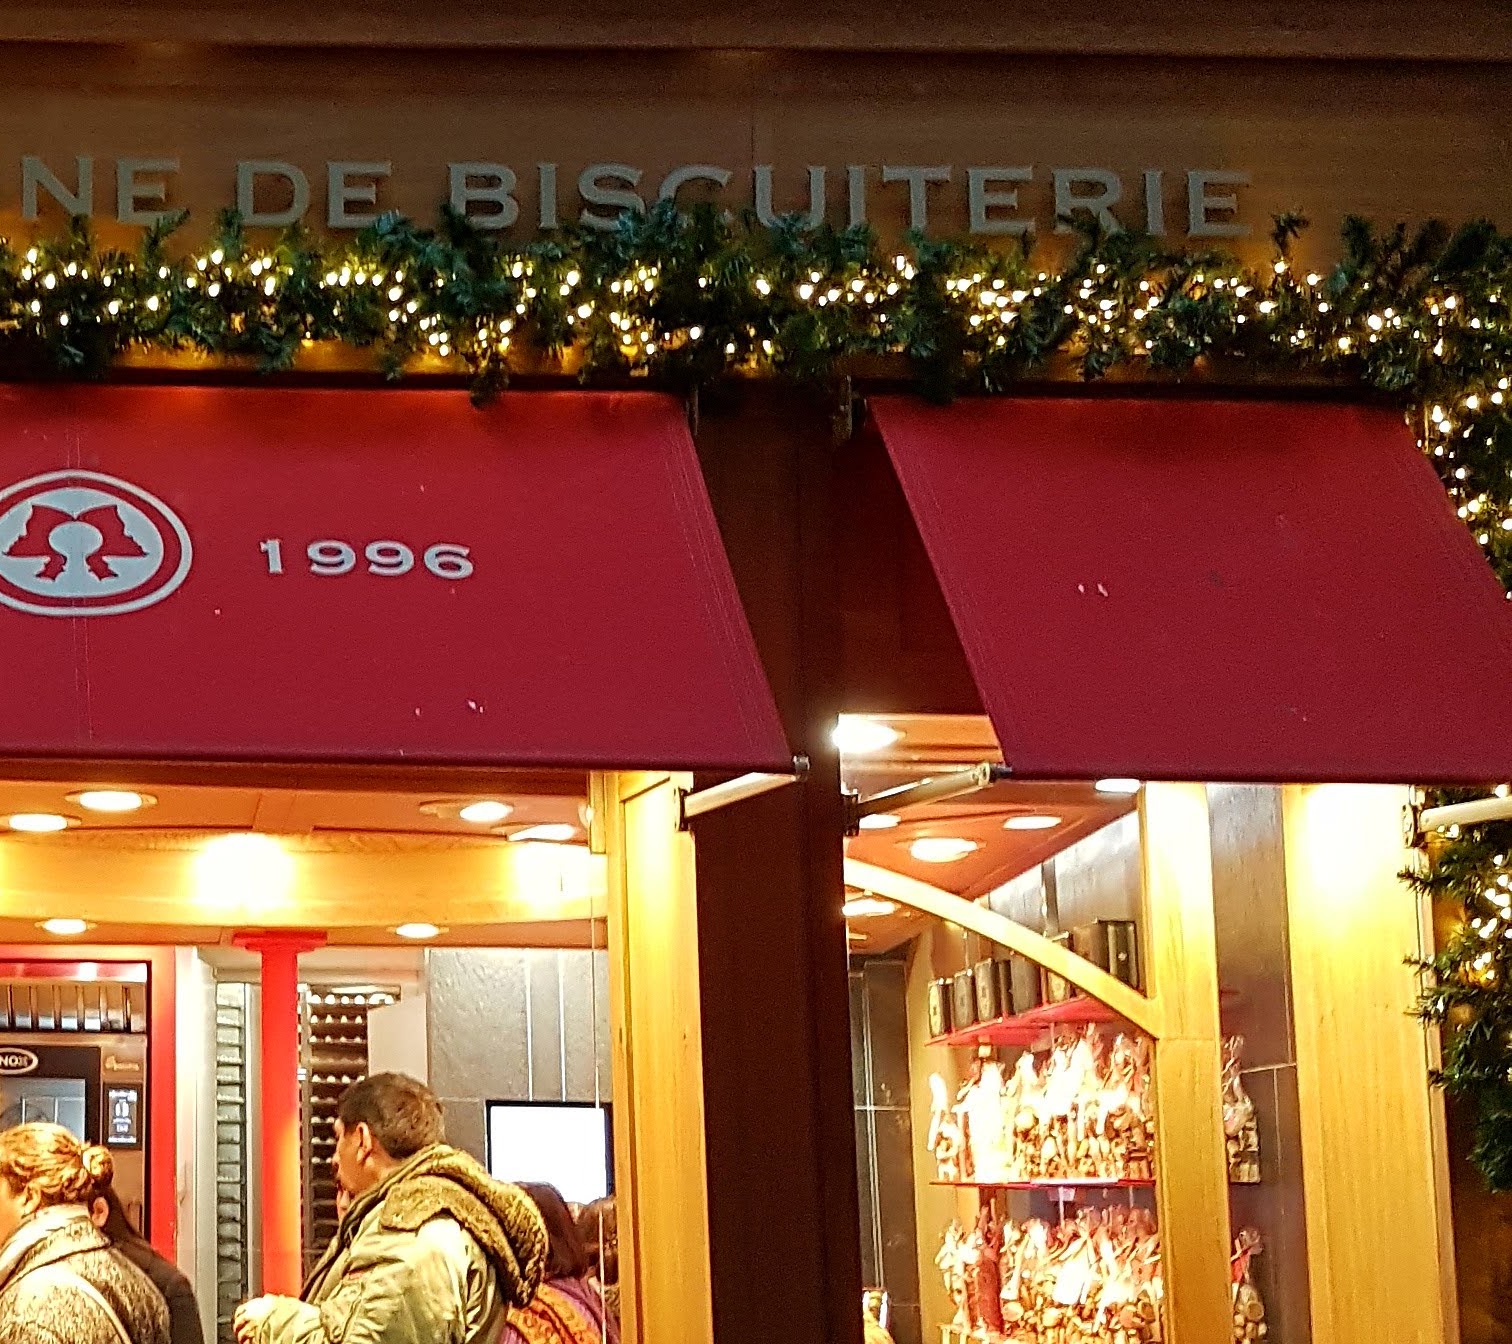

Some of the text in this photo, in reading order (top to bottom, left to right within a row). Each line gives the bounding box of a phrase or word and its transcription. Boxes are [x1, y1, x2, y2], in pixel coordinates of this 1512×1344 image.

[236, 160, 394, 228] DE
[448, 161, 1253, 236] BISCUITERIE
[260, 538, 476, 580] 1996
